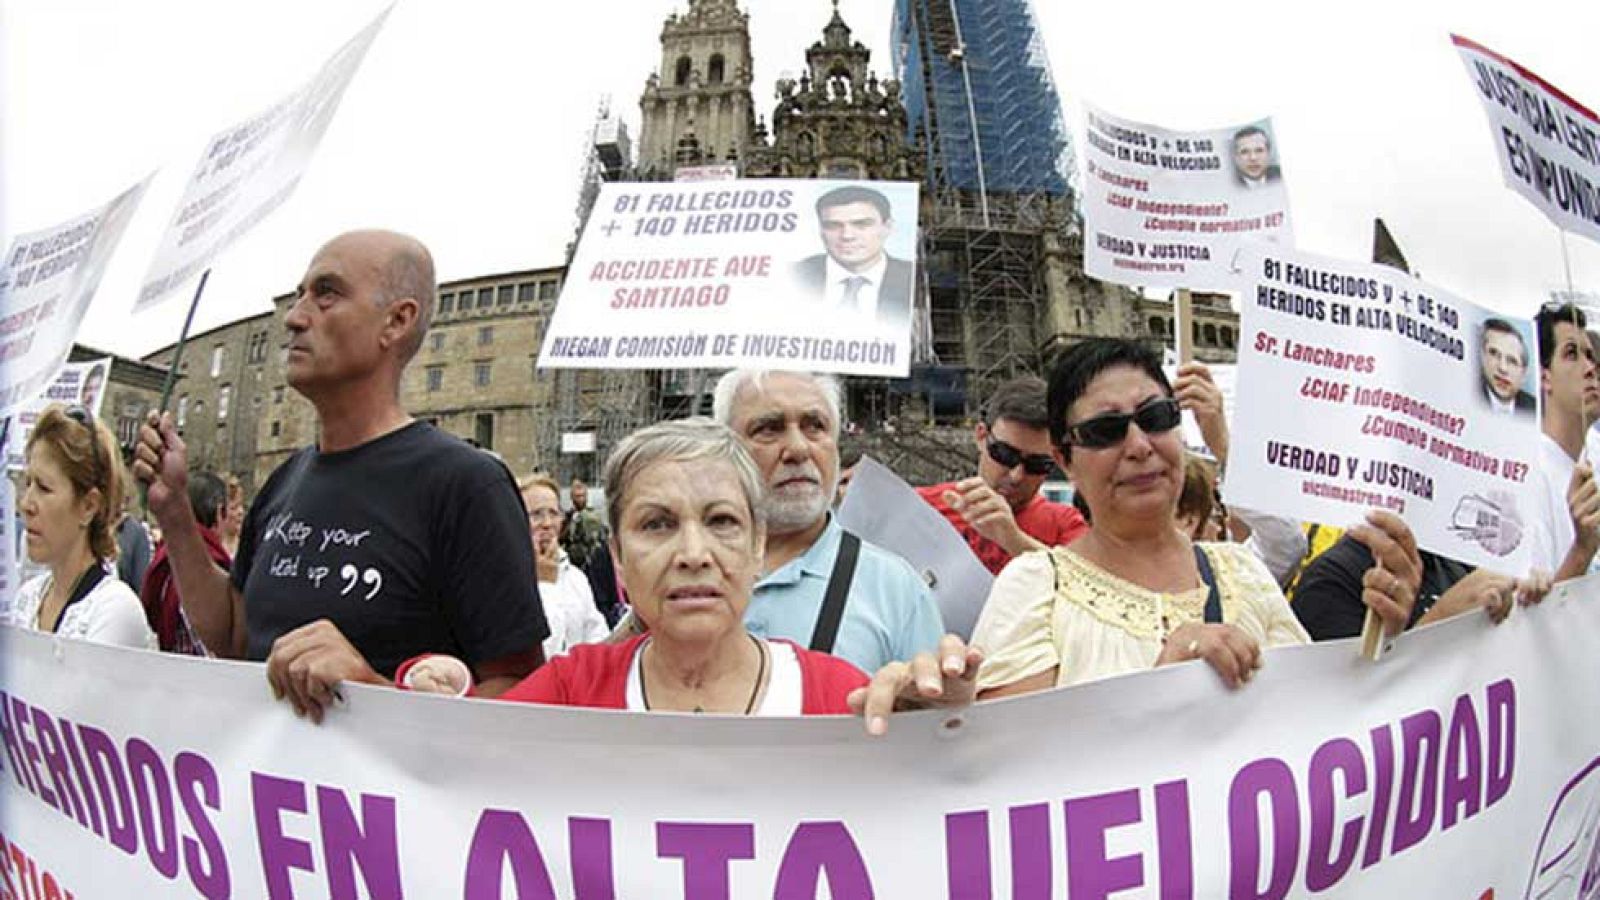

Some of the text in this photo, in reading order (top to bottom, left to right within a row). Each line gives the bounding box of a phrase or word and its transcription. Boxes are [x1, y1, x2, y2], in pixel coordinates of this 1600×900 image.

[614, 189, 792, 213] 81 FALLECIDOS
[634, 217, 676, 237] 140
[683, 212, 798, 236] HERIDOS
[1150, 244, 1210, 260] JUSTICIA
[590, 255, 771, 281] ACCIDENTE AVE
[610, 284, 730, 309] SANTIAGO
[1264, 258, 1281, 281] 81
[1286, 263, 1378, 300] FALLECIDOS
[1417, 294, 1435, 318] DE
[1437, 303, 1459, 330] 140
[1257, 285, 1464, 361] HERIDOS EN ALTA VELOCIDAD
[550, 330, 896, 365] NIEGAN COMISIÓN DE INVESTIGACIÓN
[1283, 339, 1377, 373] Lanchares
[1267, 441, 1434, 500] VERDAD Y JUSTICIA
[320, 528, 371, 552] your
[0, 690, 231, 900] HERIDOS
[945, 678, 1517, 900] VELOCIDAD
